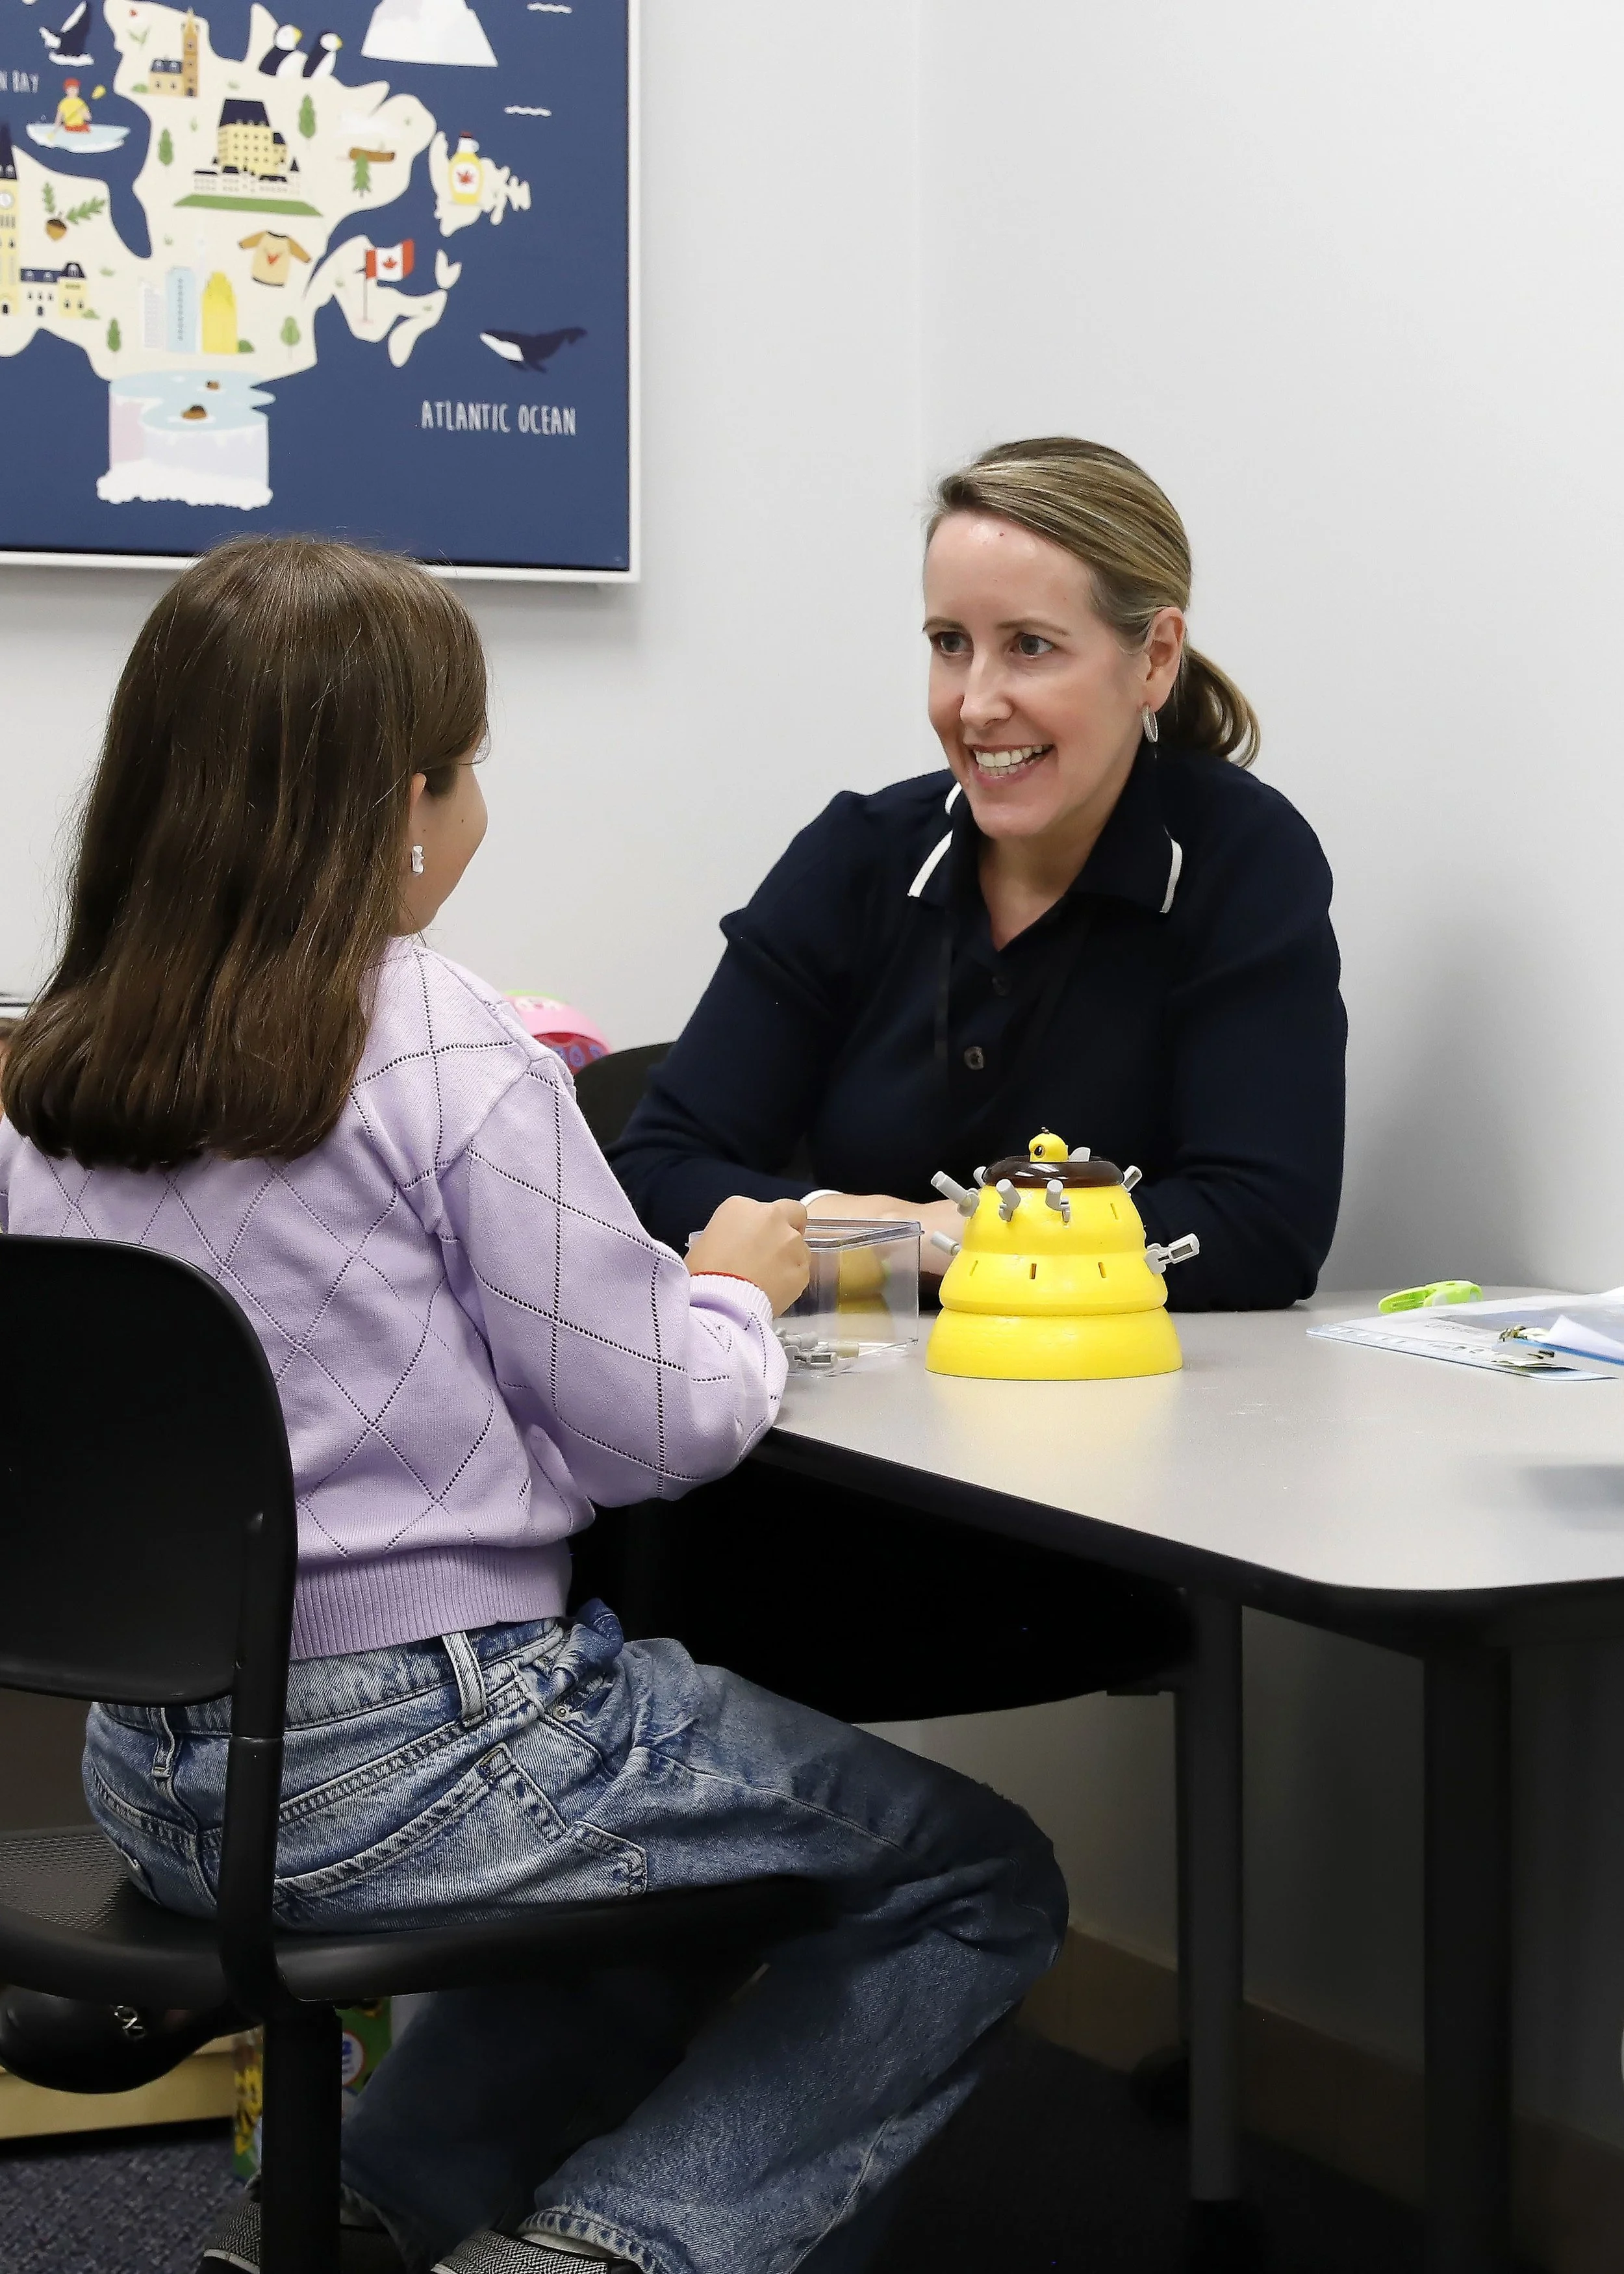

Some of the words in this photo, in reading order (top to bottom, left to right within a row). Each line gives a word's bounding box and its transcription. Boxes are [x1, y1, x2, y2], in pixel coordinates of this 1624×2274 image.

[12, 70, 39, 93] BAY
[422, 400, 510, 433] ATLANTIC
[518, 403, 576, 436] OCEAN
